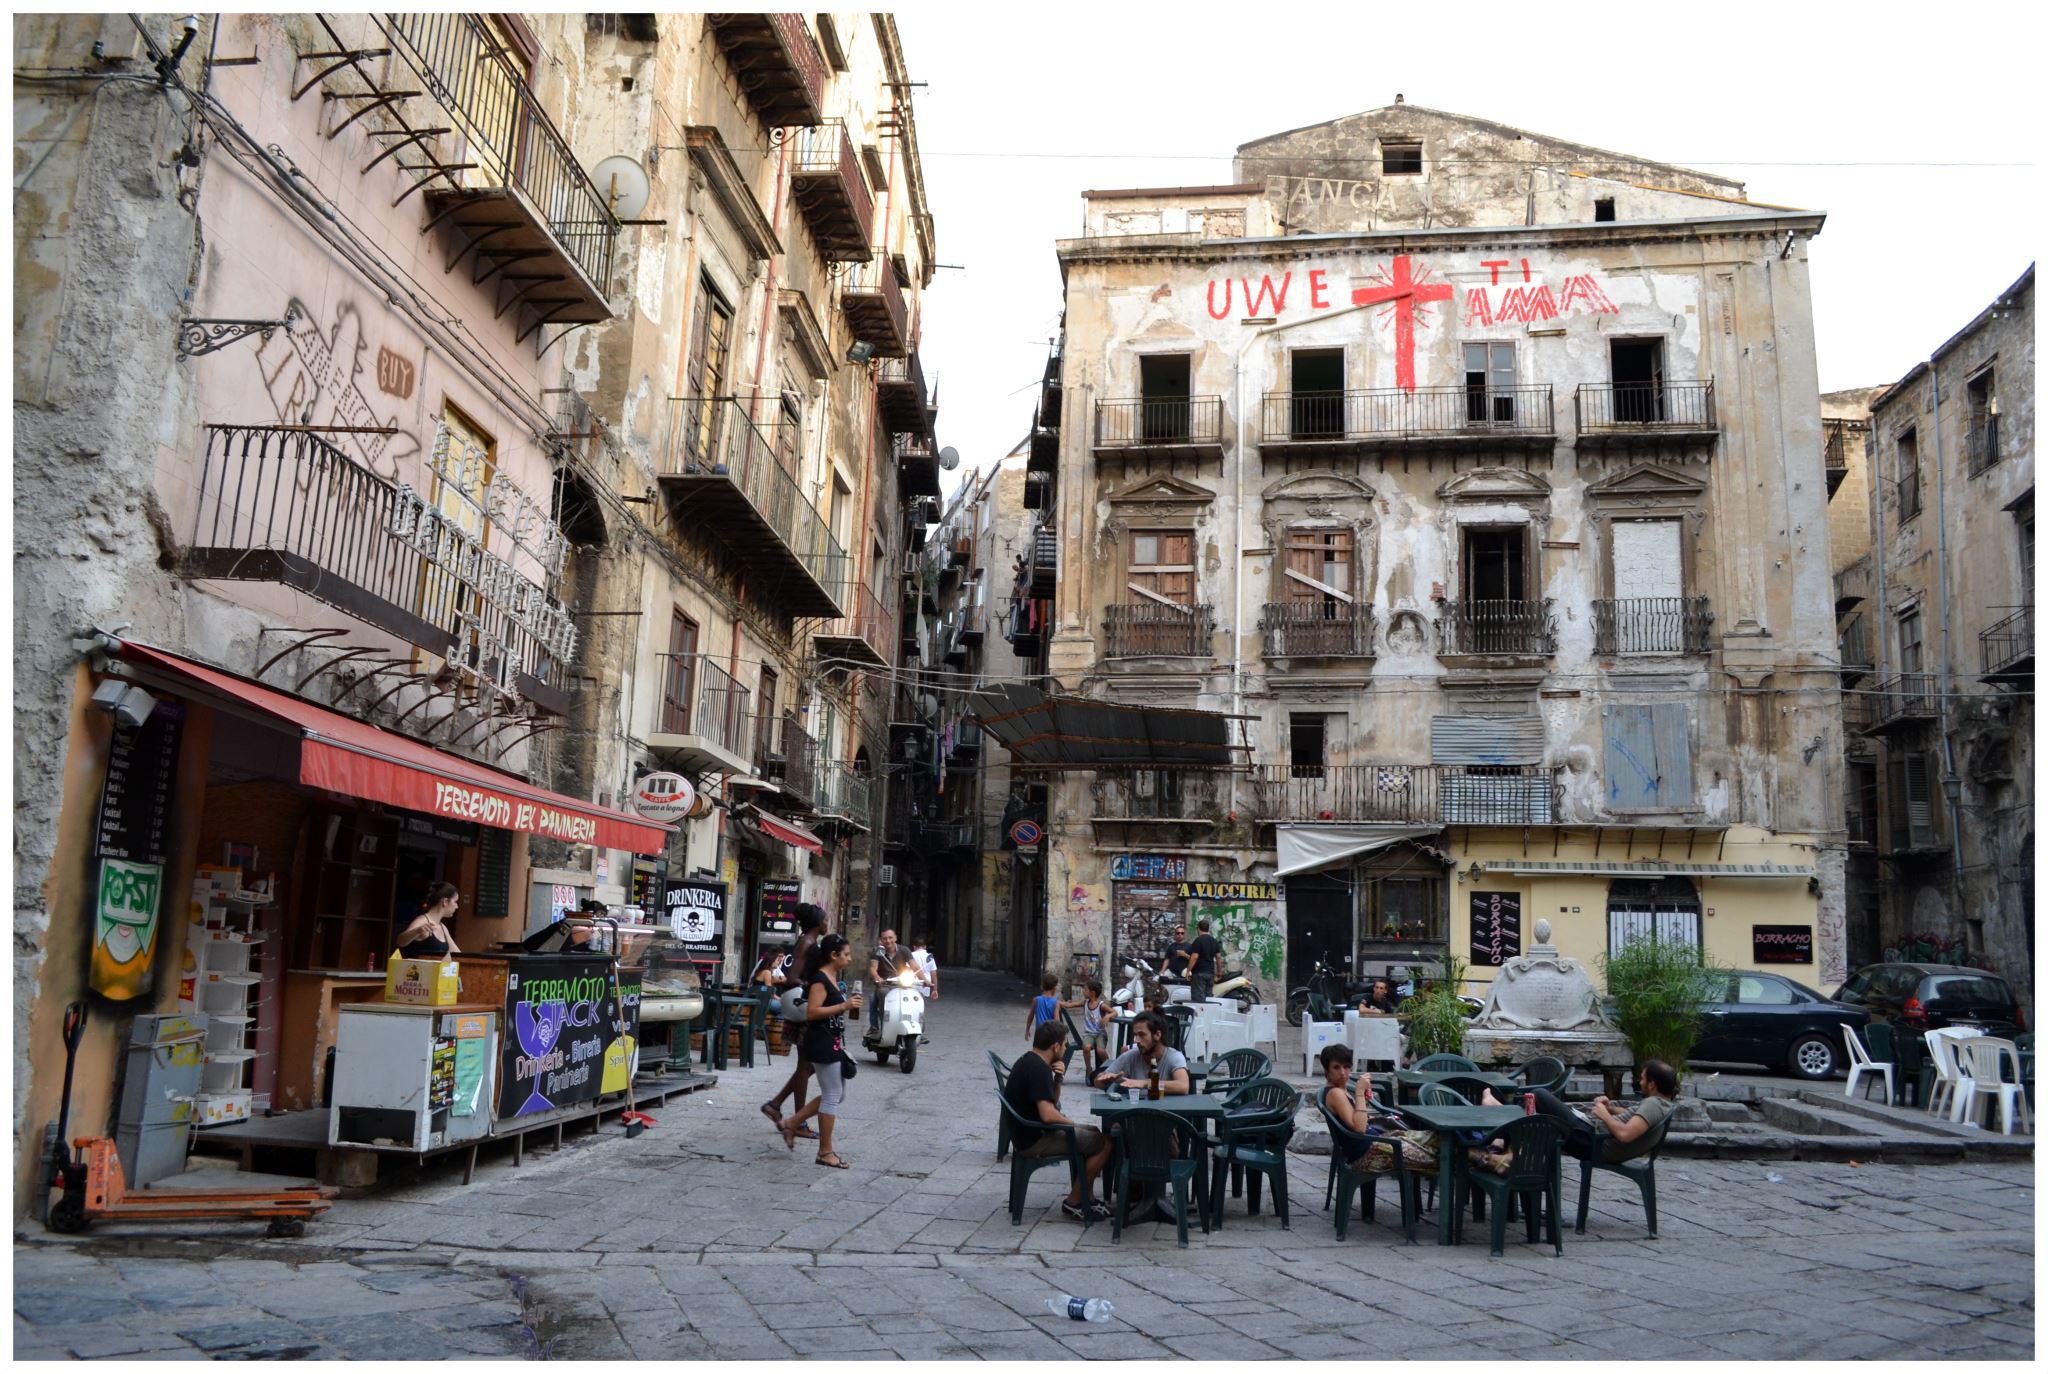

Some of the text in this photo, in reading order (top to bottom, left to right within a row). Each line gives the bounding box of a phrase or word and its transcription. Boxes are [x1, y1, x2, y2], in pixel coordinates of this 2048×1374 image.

[1262, 175, 1397, 212] BANCA
[1480, 258, 1531, 287] TI
[1207, 268, 1331, 320] UWE
[1467, 274, 1620, 327] AMA
[380, 349, 411, 398] BUY
[648, 778, 678, 794] ITI
[539, 811, 597, 843] PANINERIA
[102, 866, 159, 914] FORST
[666, 887, 722, 910] DRINKERIA
[1195, 884, 1277, 899] VUCCIRIA
[1490, 894, 1502, 964] BORRACHO
[1755, 933, 1811, 944] BORRACHO
[394, 984, 430, 997] MORETTI
[523, 976, 605, 1008] TERREMOTO
[610, 985, 641, 998] TEREMOTO
[548, 1000, 600, 1037] JACK
[516, 1046, 564, 1081] Drinkeria
[571, 1034, 602, 1064] Birreria
[546, 1062, 590, 1096] Panineria
